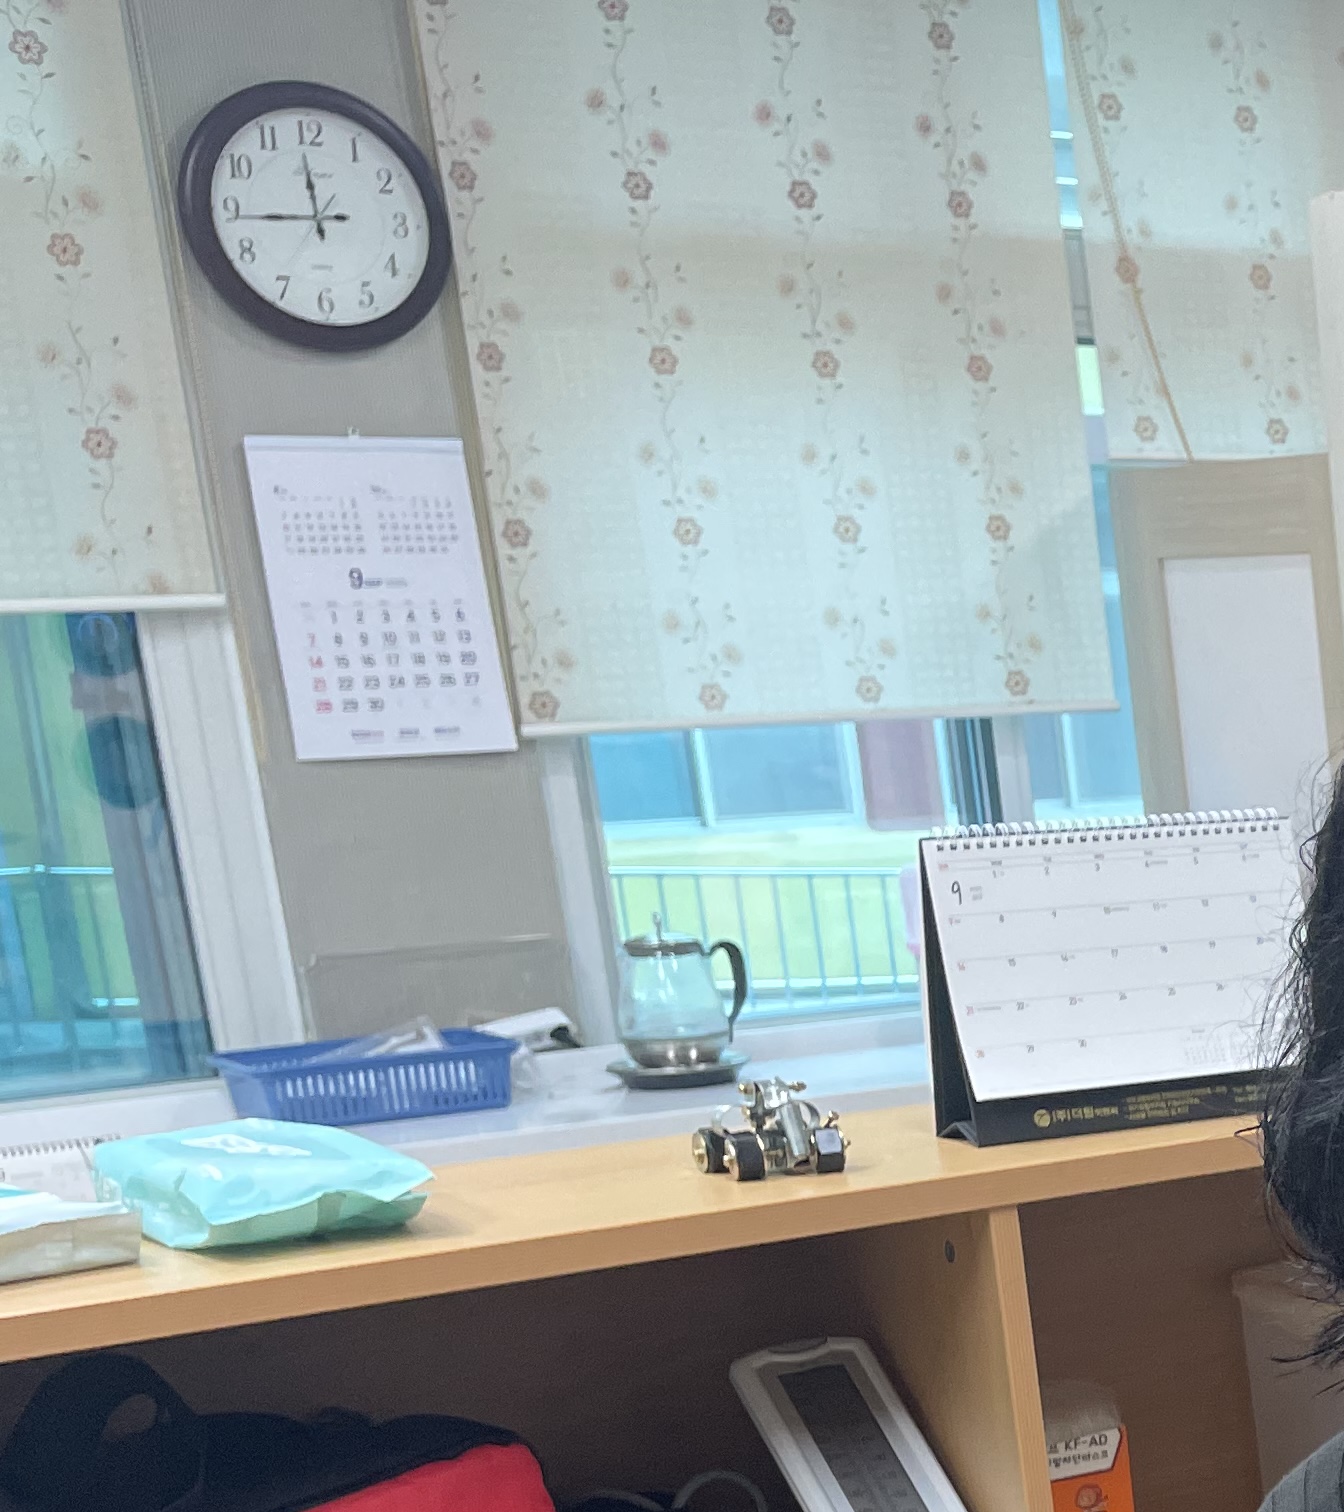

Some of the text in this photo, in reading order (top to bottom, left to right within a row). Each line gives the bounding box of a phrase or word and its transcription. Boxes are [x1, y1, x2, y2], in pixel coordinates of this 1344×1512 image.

[258, 124, 278, 150] 11
[297, 119, 323, 147] 12
[350, 137, 360, 163] 1
[229, 153, 252, 179] 10
[376, 168, 393, 194] 2
[222, 196, 240, 223] 9
[393, 212, 409, 239] 3
[239, 237, 256, 264] 8
[384, 252, 399, 279] 4
[275, 275, 290, 301] 7
[359, 281, 374, 308] 5
[317, 288, 334, 317] 6
[951, 881, 962, 905] 9
